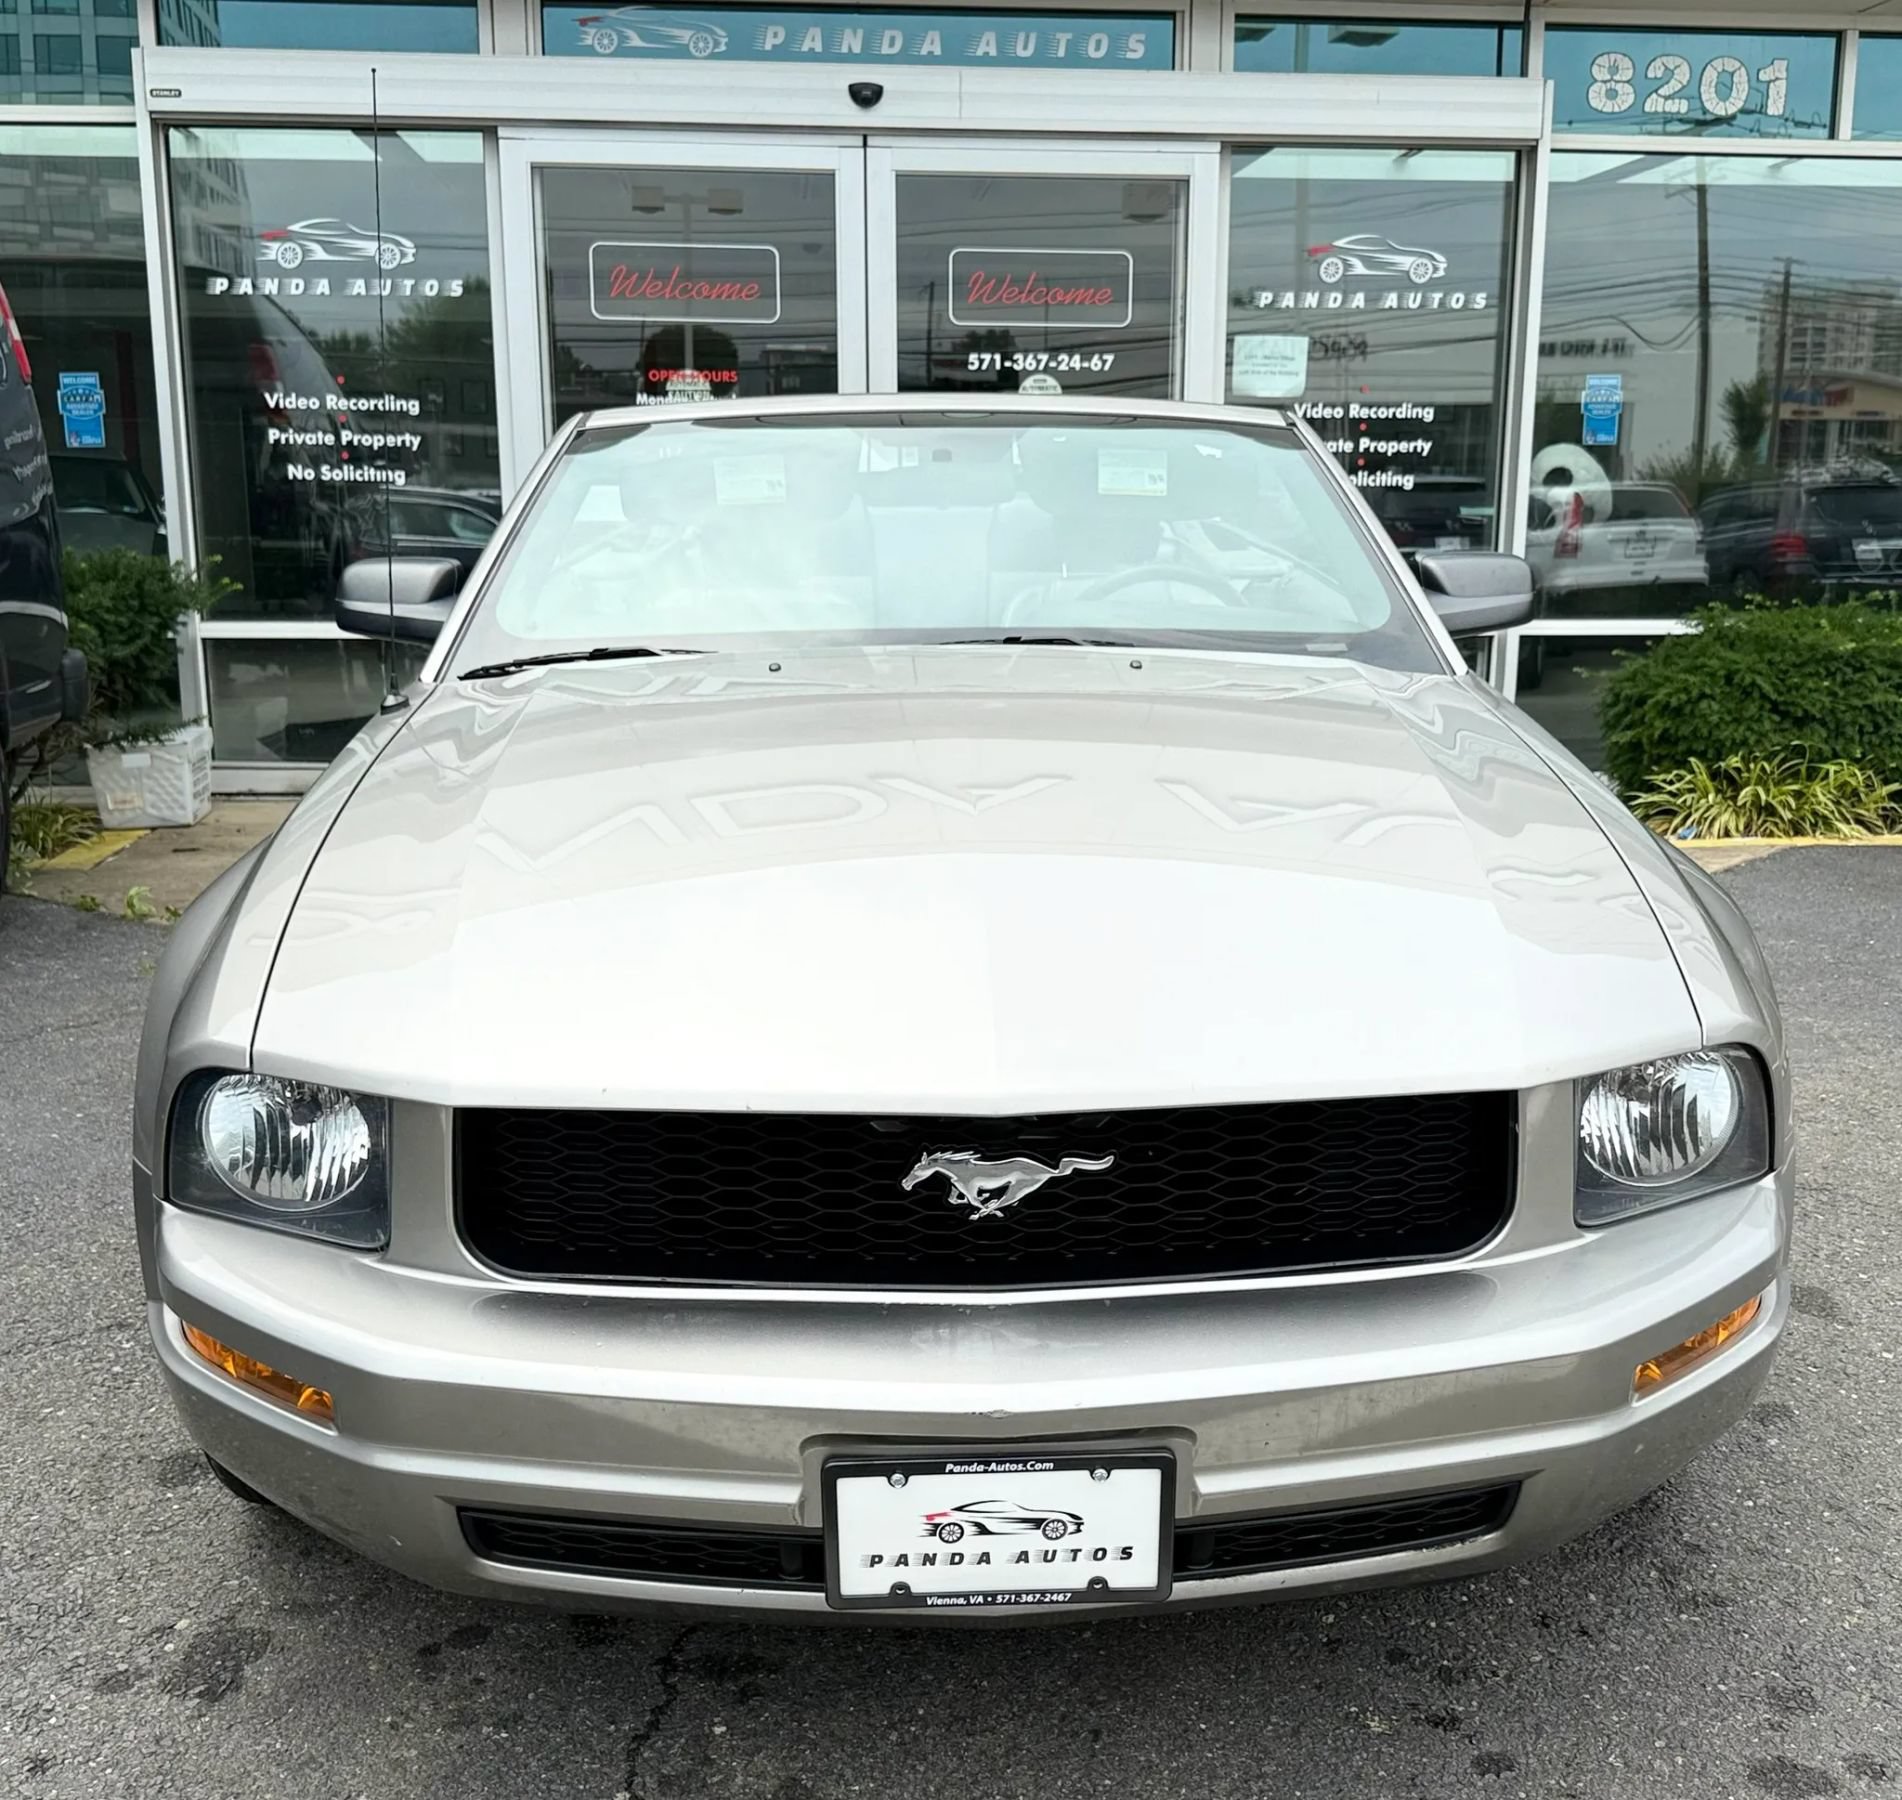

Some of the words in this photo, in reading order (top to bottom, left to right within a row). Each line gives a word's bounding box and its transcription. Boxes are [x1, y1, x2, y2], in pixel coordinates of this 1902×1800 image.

[757, 25, 942, 56] PANDA
[969, 31, 1146, 59] AUTOS
[1587, 51, 1789, 117] 8201
[209, 277, 331, 296] PANDA
[347, 278, 464, 298] AUTOS
[609, 264, 761, 302] Welcome
[967, 271, 1114, 306] Welcome
[1256, 291, 1366, 309] PANDA
[1379, 291, 1488, 309] AUTOS
[967, 352, 1116, 372] 571-367-24-67
[263, 392, 321, 410] Video
[325, 394, 421, 416] Recording
[1294, 402, 1345, 419] Video
[1349, 402, 1435, 423] Recording
[267, 428, 336, 446] Private
[340, 429, 422, 451] Property
[1358, 436, 1433, 457] Property
[287, 463, 316, 481] No
[320, 463, 407, 486] Soliciting
[944, 1460, 1055, 1473] Panda-Autos.Com
[862, 1551, 992, 1568] PANDA
[1008, 1546, 1134, 1564] AUTOS
[925, 1594, 968, 1606] Vienna,
[969, 1594, 985, 1605] VA
[995, 1592, 1073, 1604] 571-367-2467
